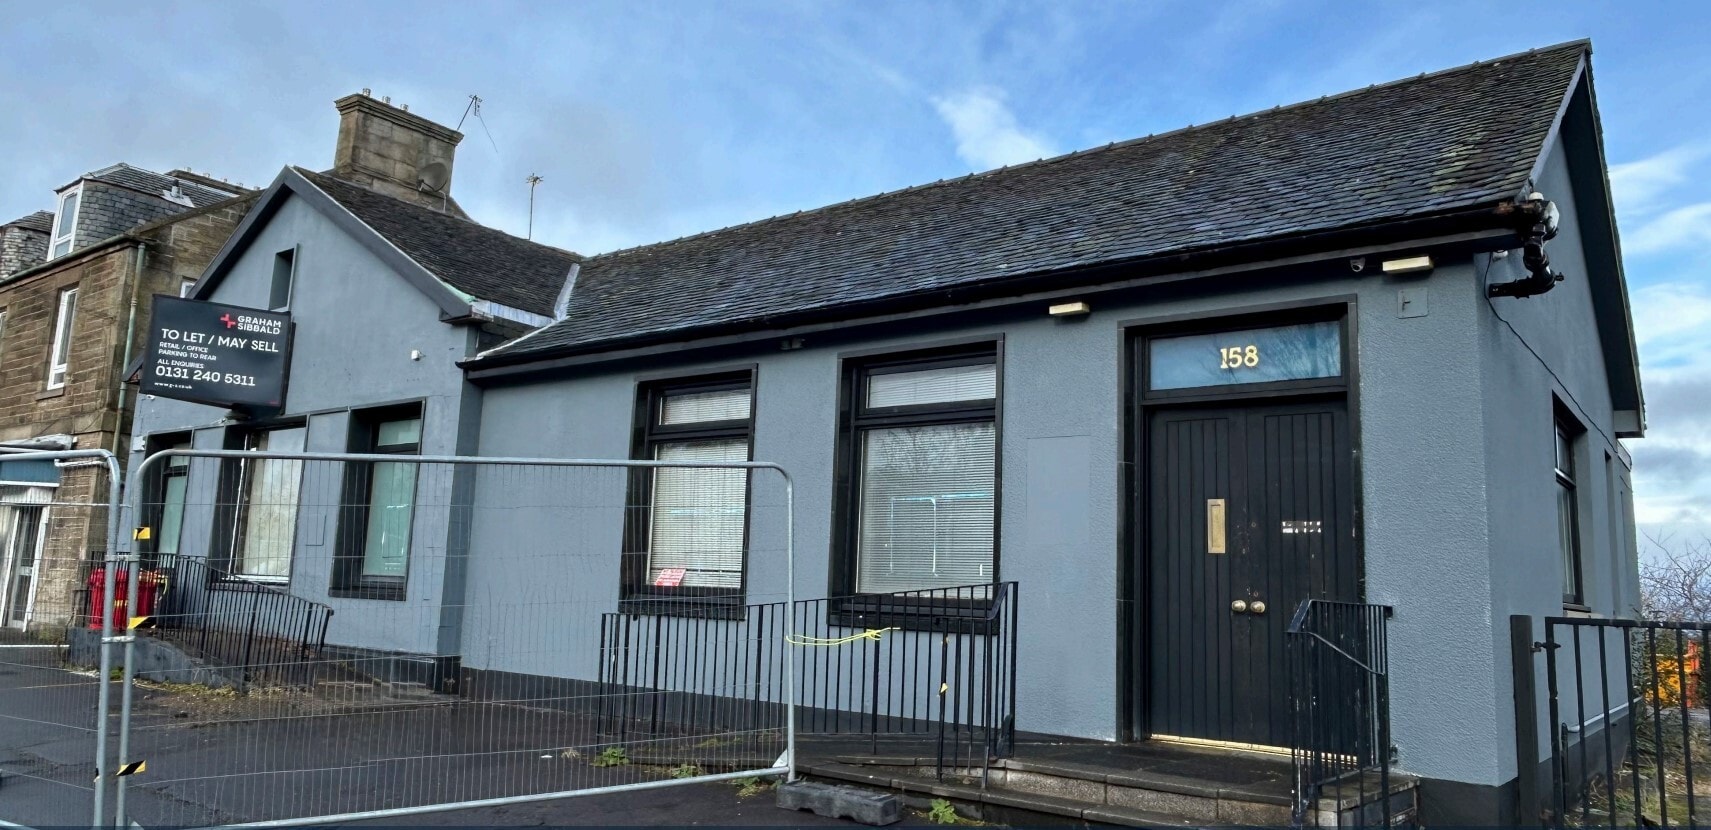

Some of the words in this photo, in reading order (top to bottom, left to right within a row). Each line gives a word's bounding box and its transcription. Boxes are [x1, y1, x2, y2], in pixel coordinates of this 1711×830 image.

[237, 316, 282, 328] GRAHAM
[237, 323, 281, 335] SIBBALD
[161, 328, 180, 340] TO
[183, 331, 205, 344] LET
[208, 335, 215, 345] /
[217, 335, 248, 349] MAY
[251, 340, 279, 352] SELL
[159, 341, 180, 350] RETAIL
[186, 345, 209, 353] OFFICE
[158, 348, 188, 358] PARKING
[199, 353, 217, 361] REAR
[1220, 345, 1259, 369] 158
[171, 359, 205, 369] ENQUIRIES
[155, 365, 189, 379] 0131
[192, 370, 221, 383] 240
[224, 374, 256, 387] 5311
